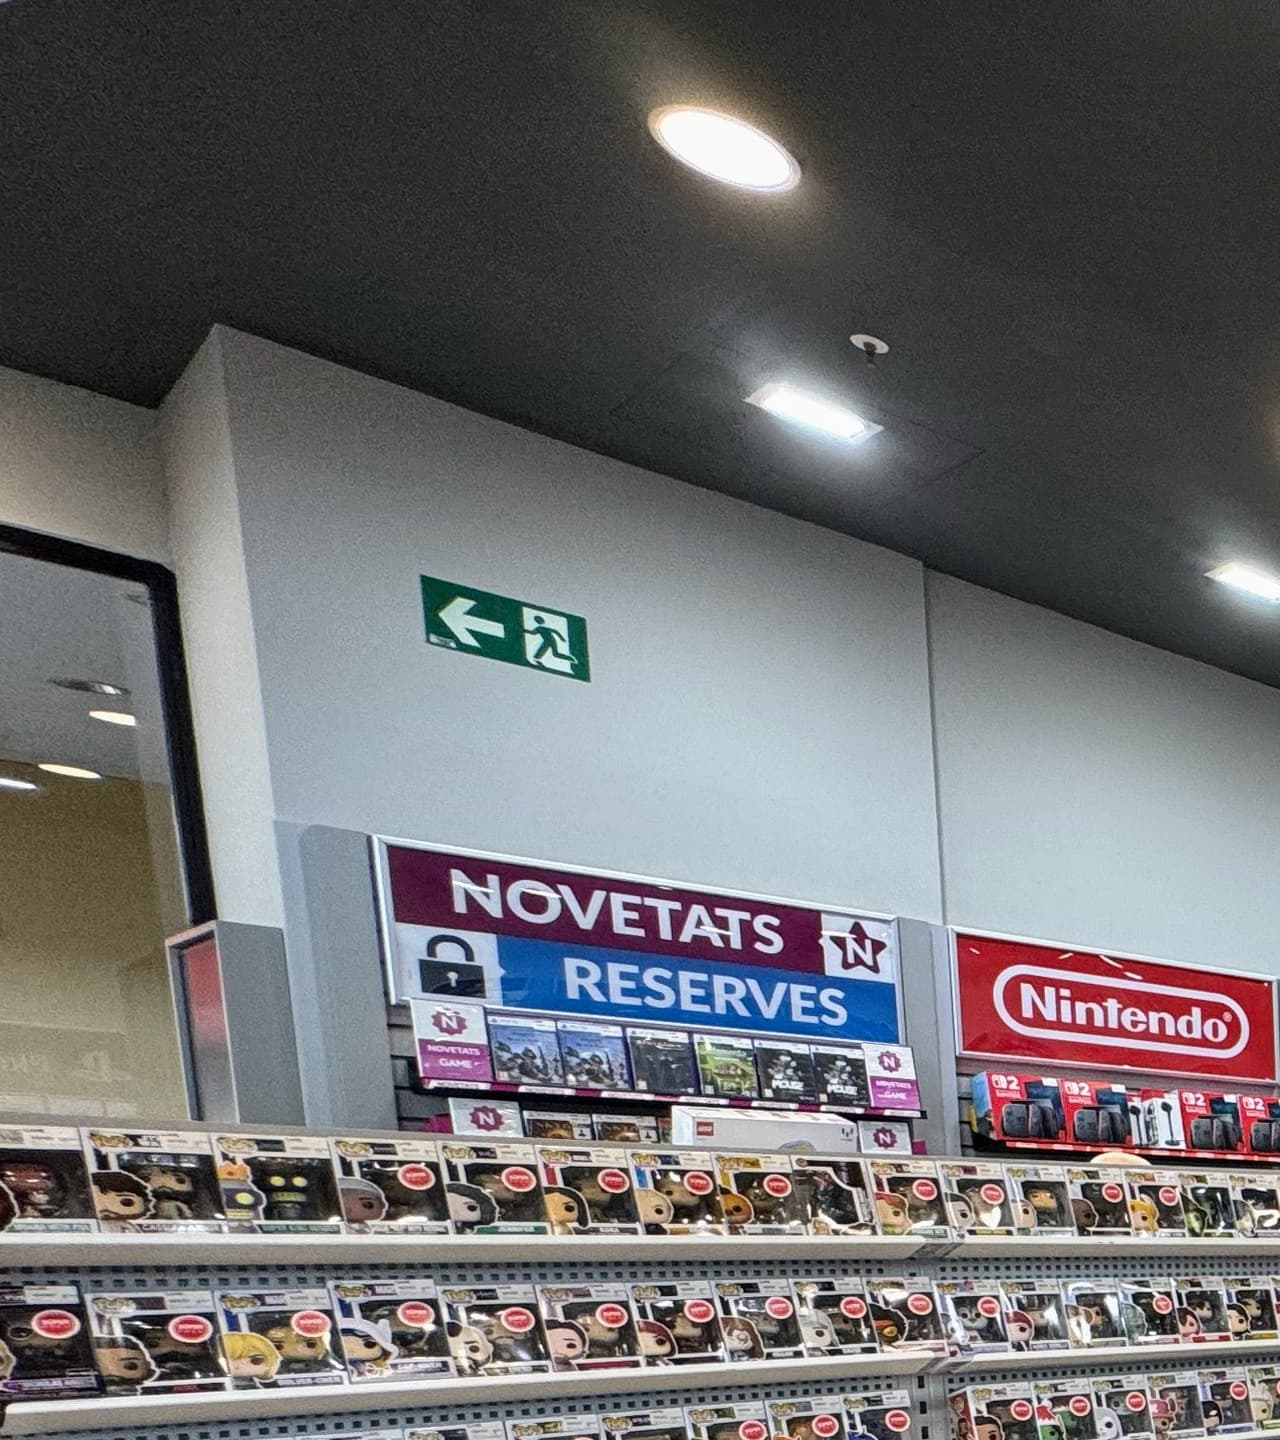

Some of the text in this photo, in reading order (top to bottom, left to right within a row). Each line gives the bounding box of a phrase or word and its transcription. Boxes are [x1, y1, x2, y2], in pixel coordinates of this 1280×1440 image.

[450, 868, 784, 954] NOVETATS
[564, 957, 847, 1026] RESERVES
[1019, 982, 1228, 1043] Nintendo
[427, 1045, 480, 1056] NOVETATS
[439, 1058, 473, 1069] GAME
